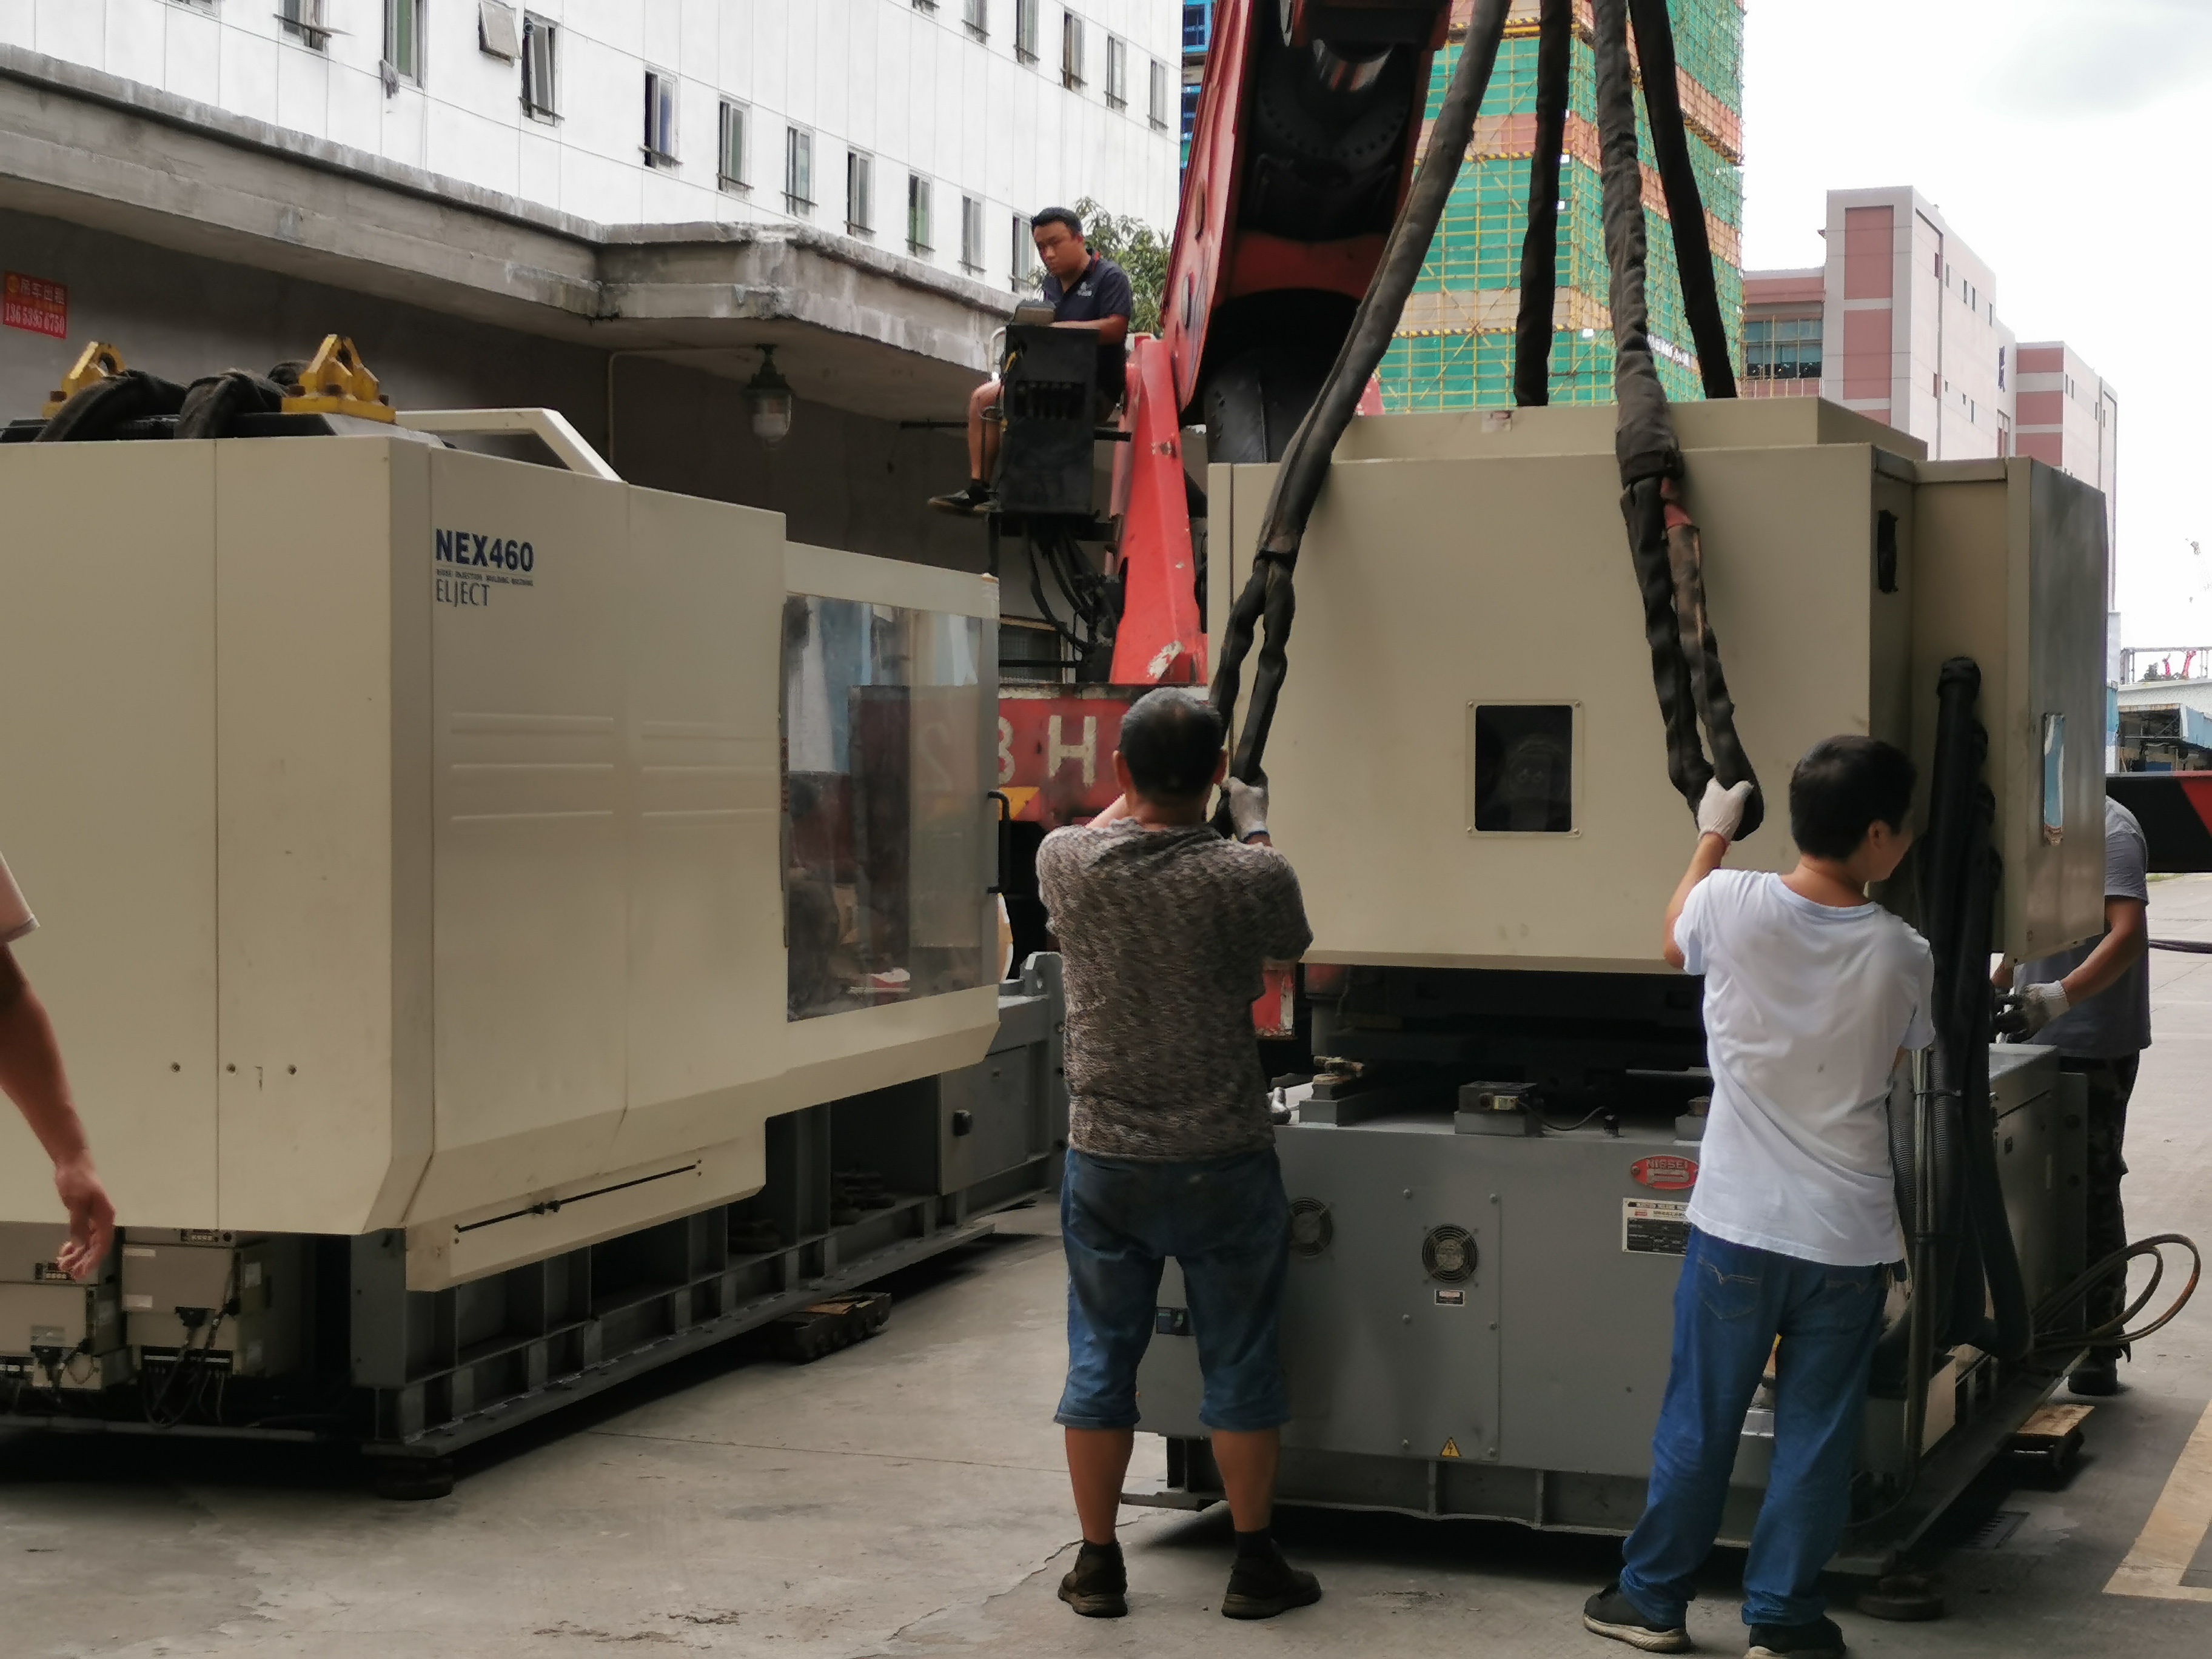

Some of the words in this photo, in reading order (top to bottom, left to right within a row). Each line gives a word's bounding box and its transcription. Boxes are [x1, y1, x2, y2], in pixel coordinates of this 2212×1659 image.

[21, 278, 65, 305] 吊车出租
[435, 528, 534, 572] NEX460
[1646, 1158, 1688, 1170] NISSEI
